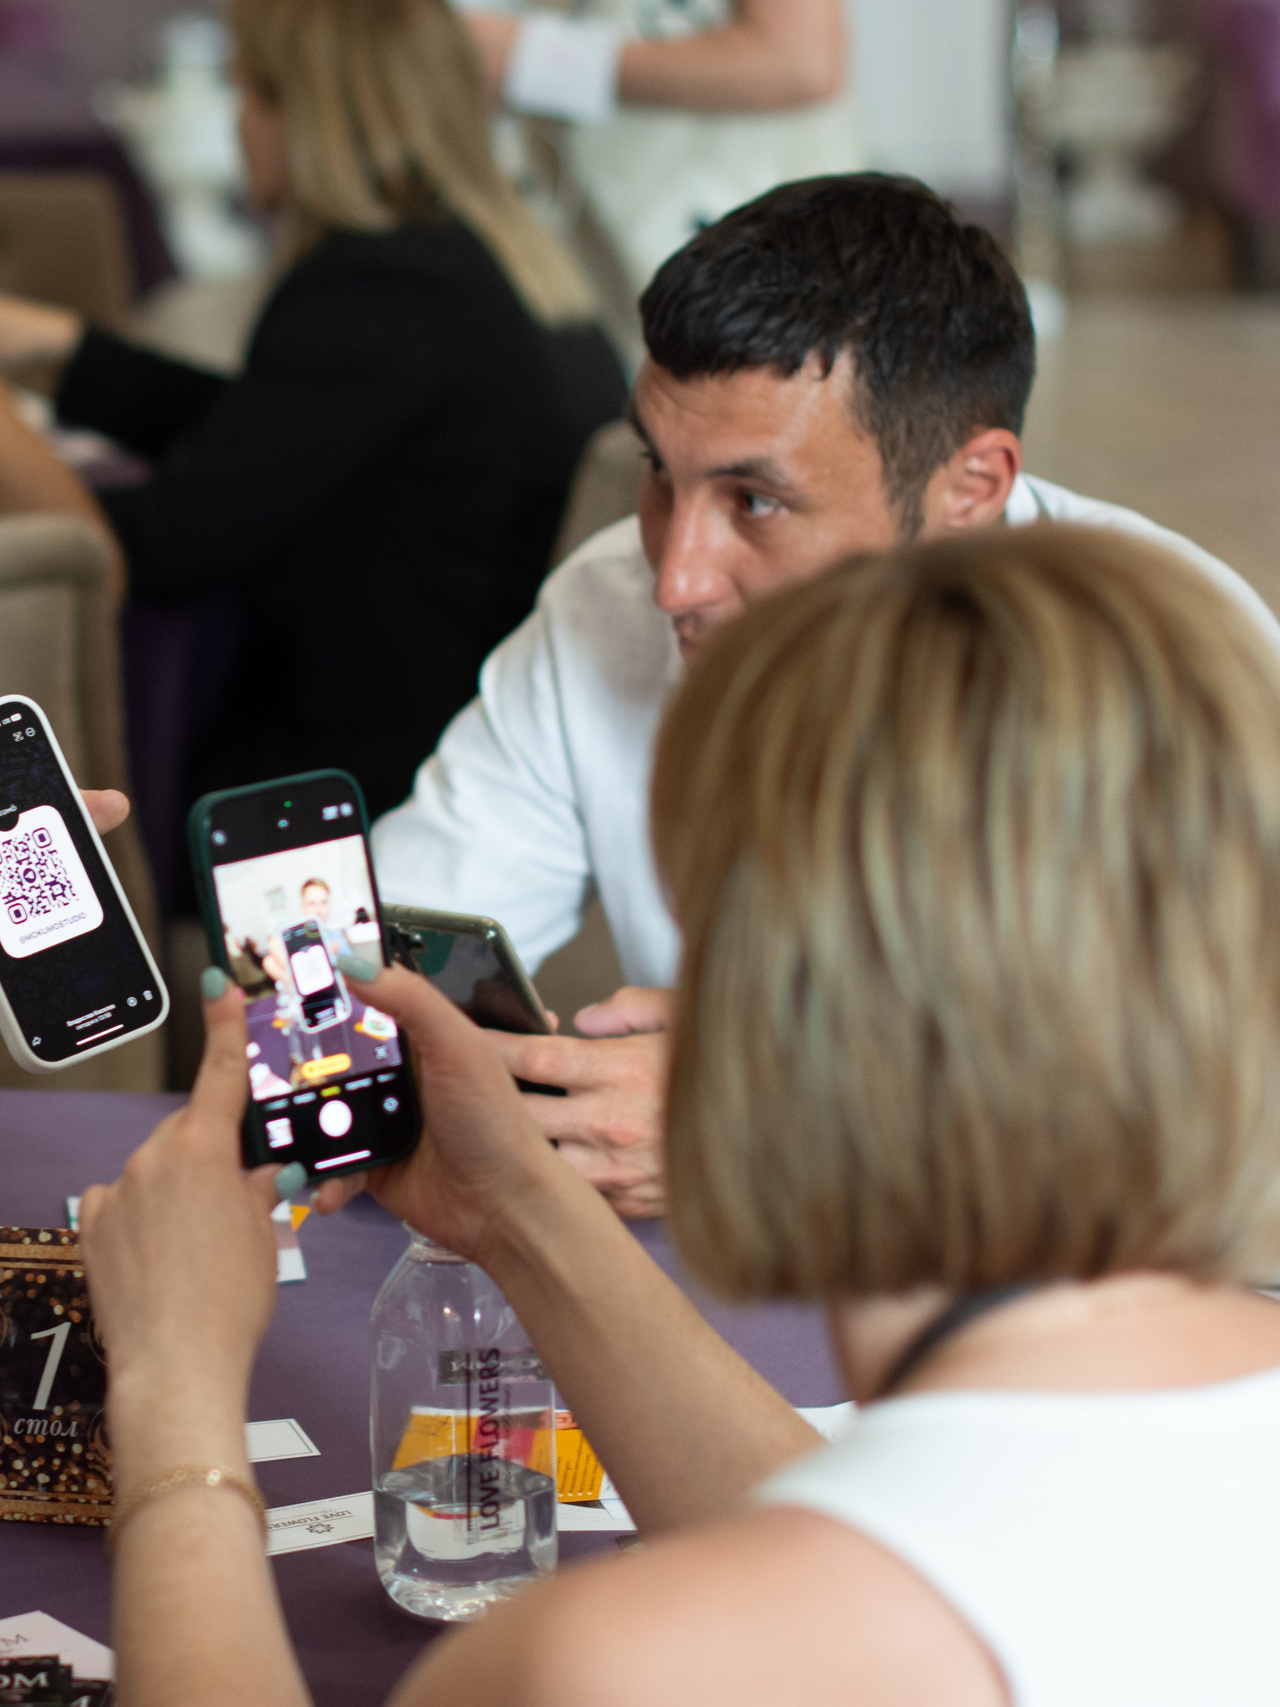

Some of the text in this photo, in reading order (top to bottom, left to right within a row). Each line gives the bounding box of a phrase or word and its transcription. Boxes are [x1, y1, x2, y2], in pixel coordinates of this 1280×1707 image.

[30, 1321, 72, 1411] 1
[13, 1416, 79, 1438] стол
[478, 1347, 502, 1531] LOVE FLOWERS
[320, 1509, 352, 1522] LOVE
